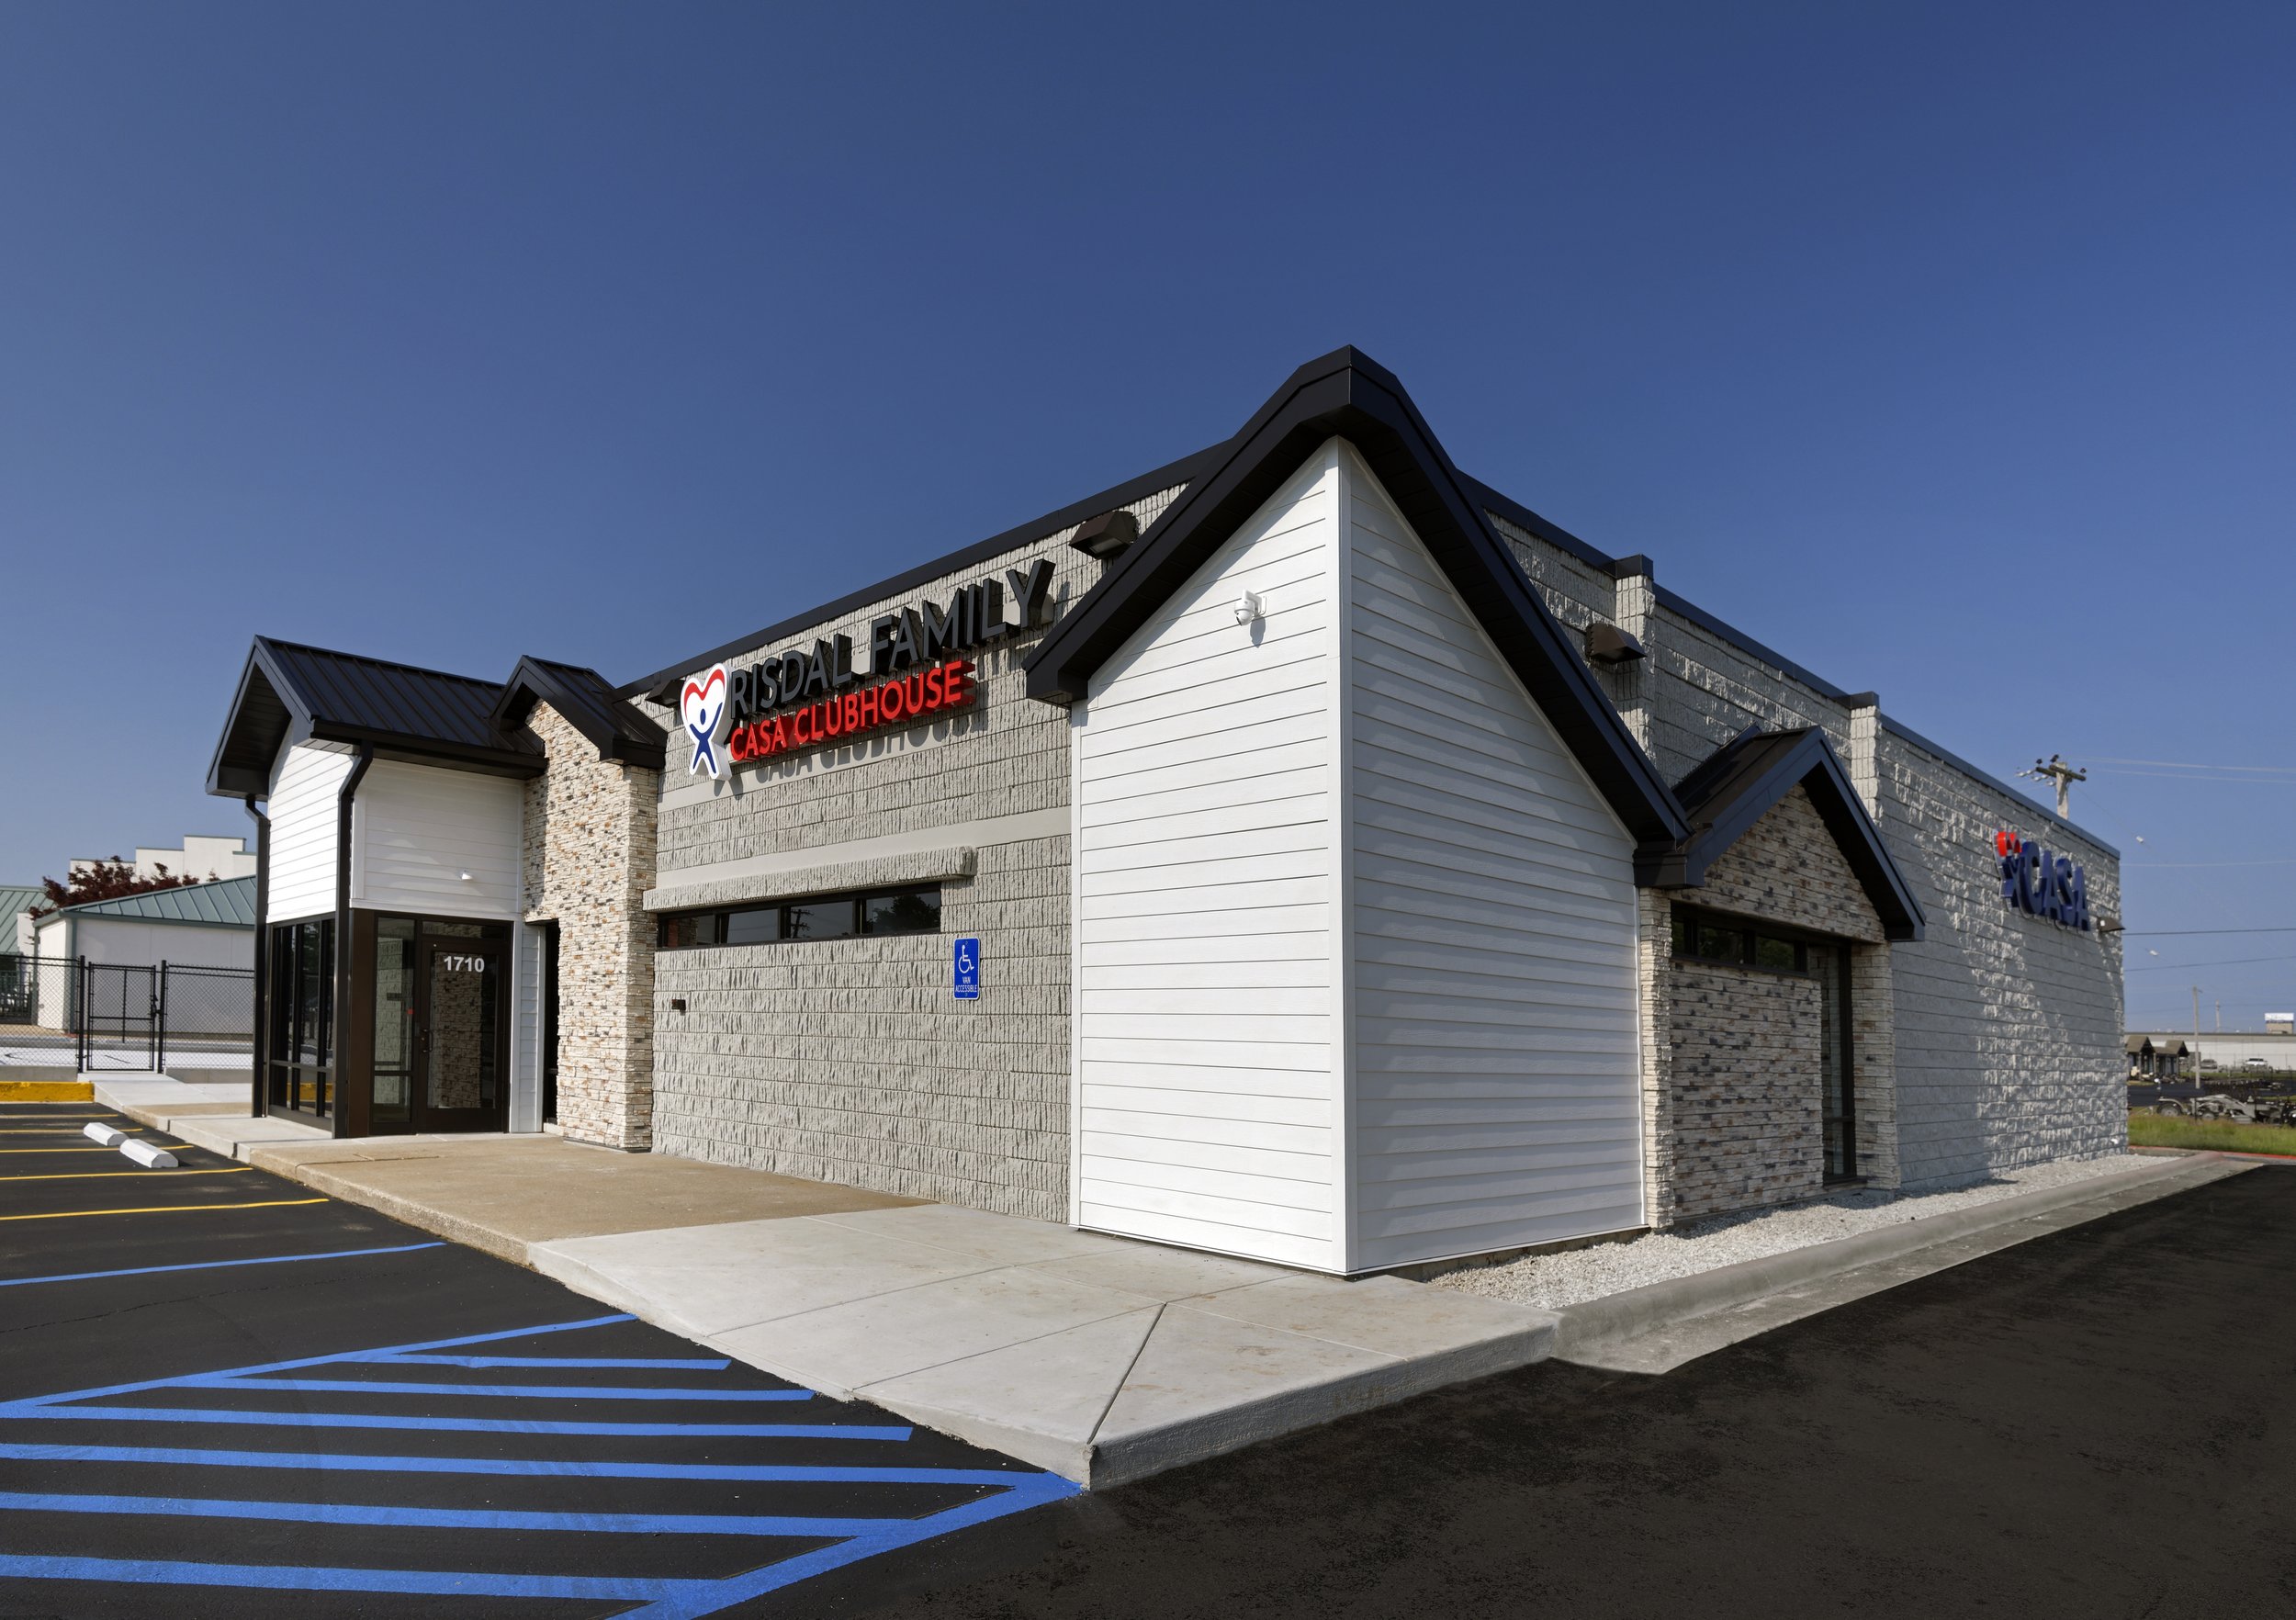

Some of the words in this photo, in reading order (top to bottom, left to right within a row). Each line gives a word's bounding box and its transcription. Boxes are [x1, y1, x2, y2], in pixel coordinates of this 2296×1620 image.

[731, 634, 852, 719] RISDAL
[870, 558, 1055, 676] FAMILY
[730, 714, 787, 761] CASA
[794, 660, 962, 744] CLUBHOUSE
[2020, 841, 2090, 931] CASA
[444, 956, 485, 973] 1710
[955, 984, 978, 993] ACCESSIBLE
[962, 976, 972, 984] VAN
